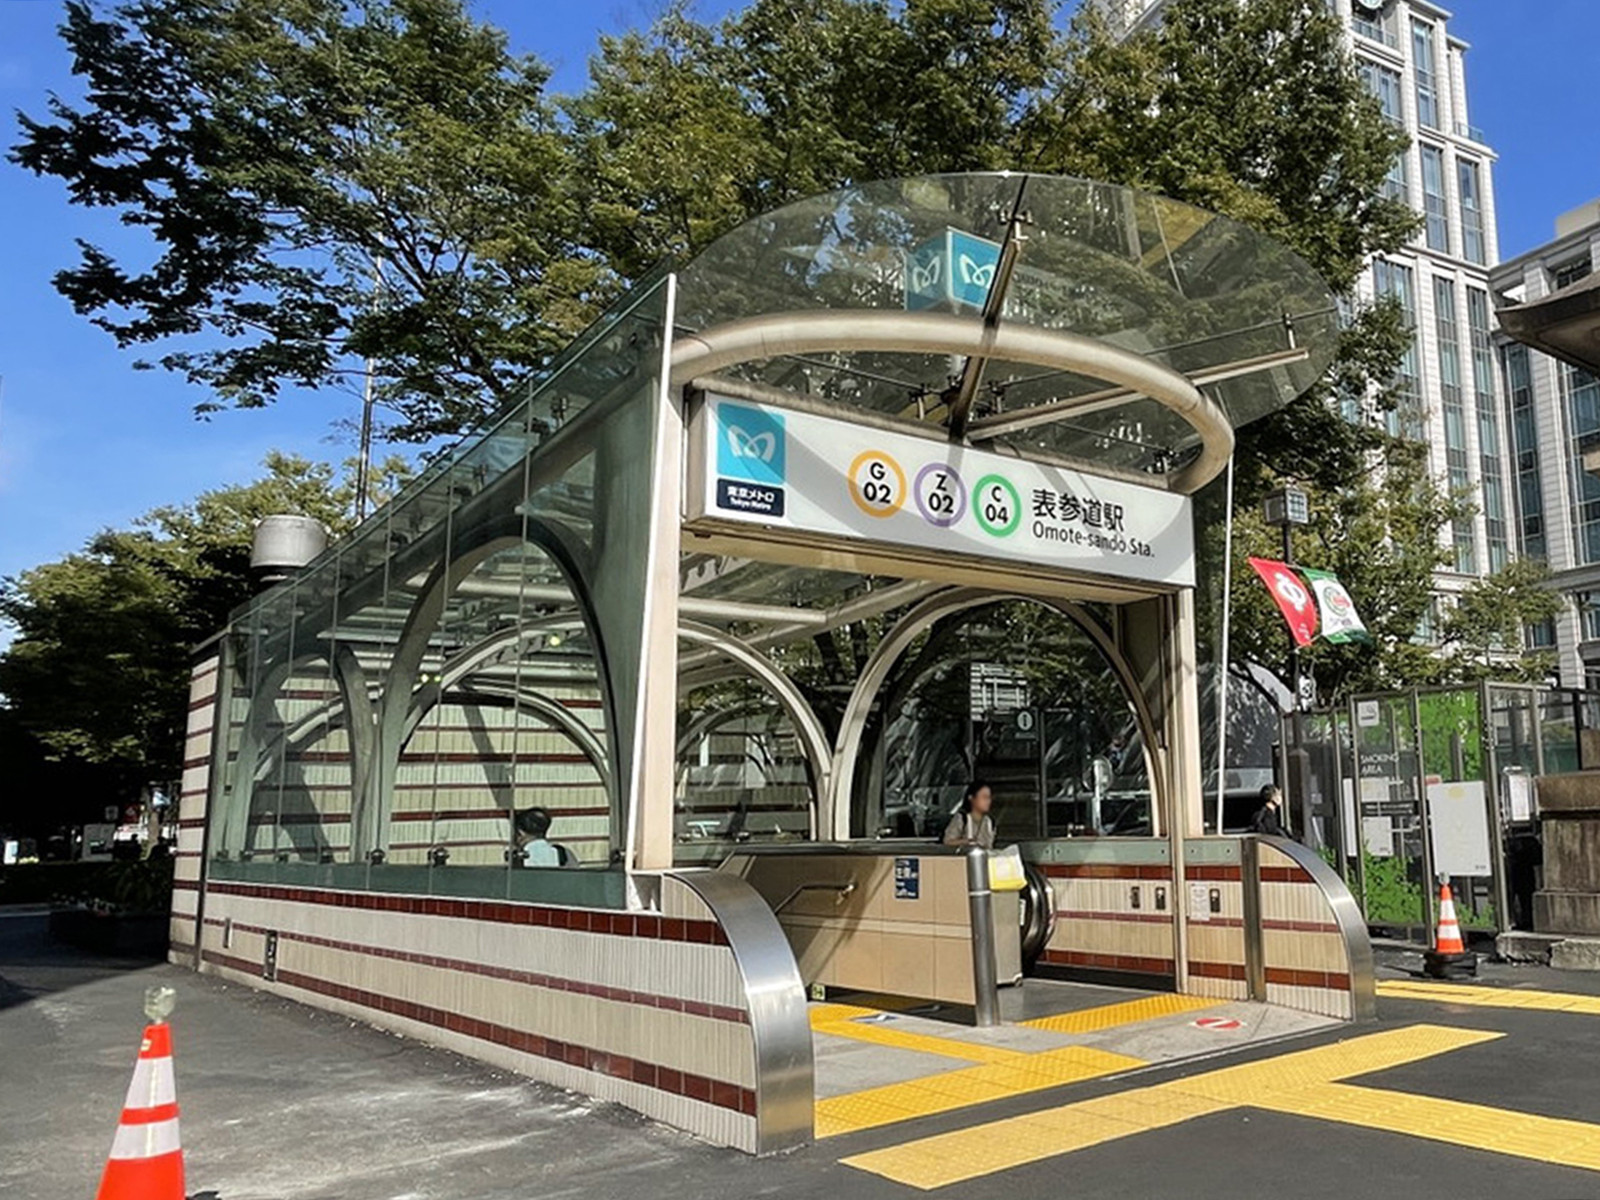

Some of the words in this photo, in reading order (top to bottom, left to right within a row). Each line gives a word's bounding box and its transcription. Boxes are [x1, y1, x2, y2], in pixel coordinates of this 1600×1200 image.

[870, 462, 886, 480] G
[935, 473, 948, 491] Z
[863, 482, 892, 504] 02
[991, 485, 1002, 502] C
[928, 492, 954, 514] 02
[1032, 489, 1124, 532] 表参道駅
[985, 503, 1009, 524] 04
[1032, 520, 1127, 553] Omote-sando
[1128, 538, 1155, 558] Sta.
[1360, 752, 1399, 765] SMOKING
[1361, 764, 1383, 776] AREA
